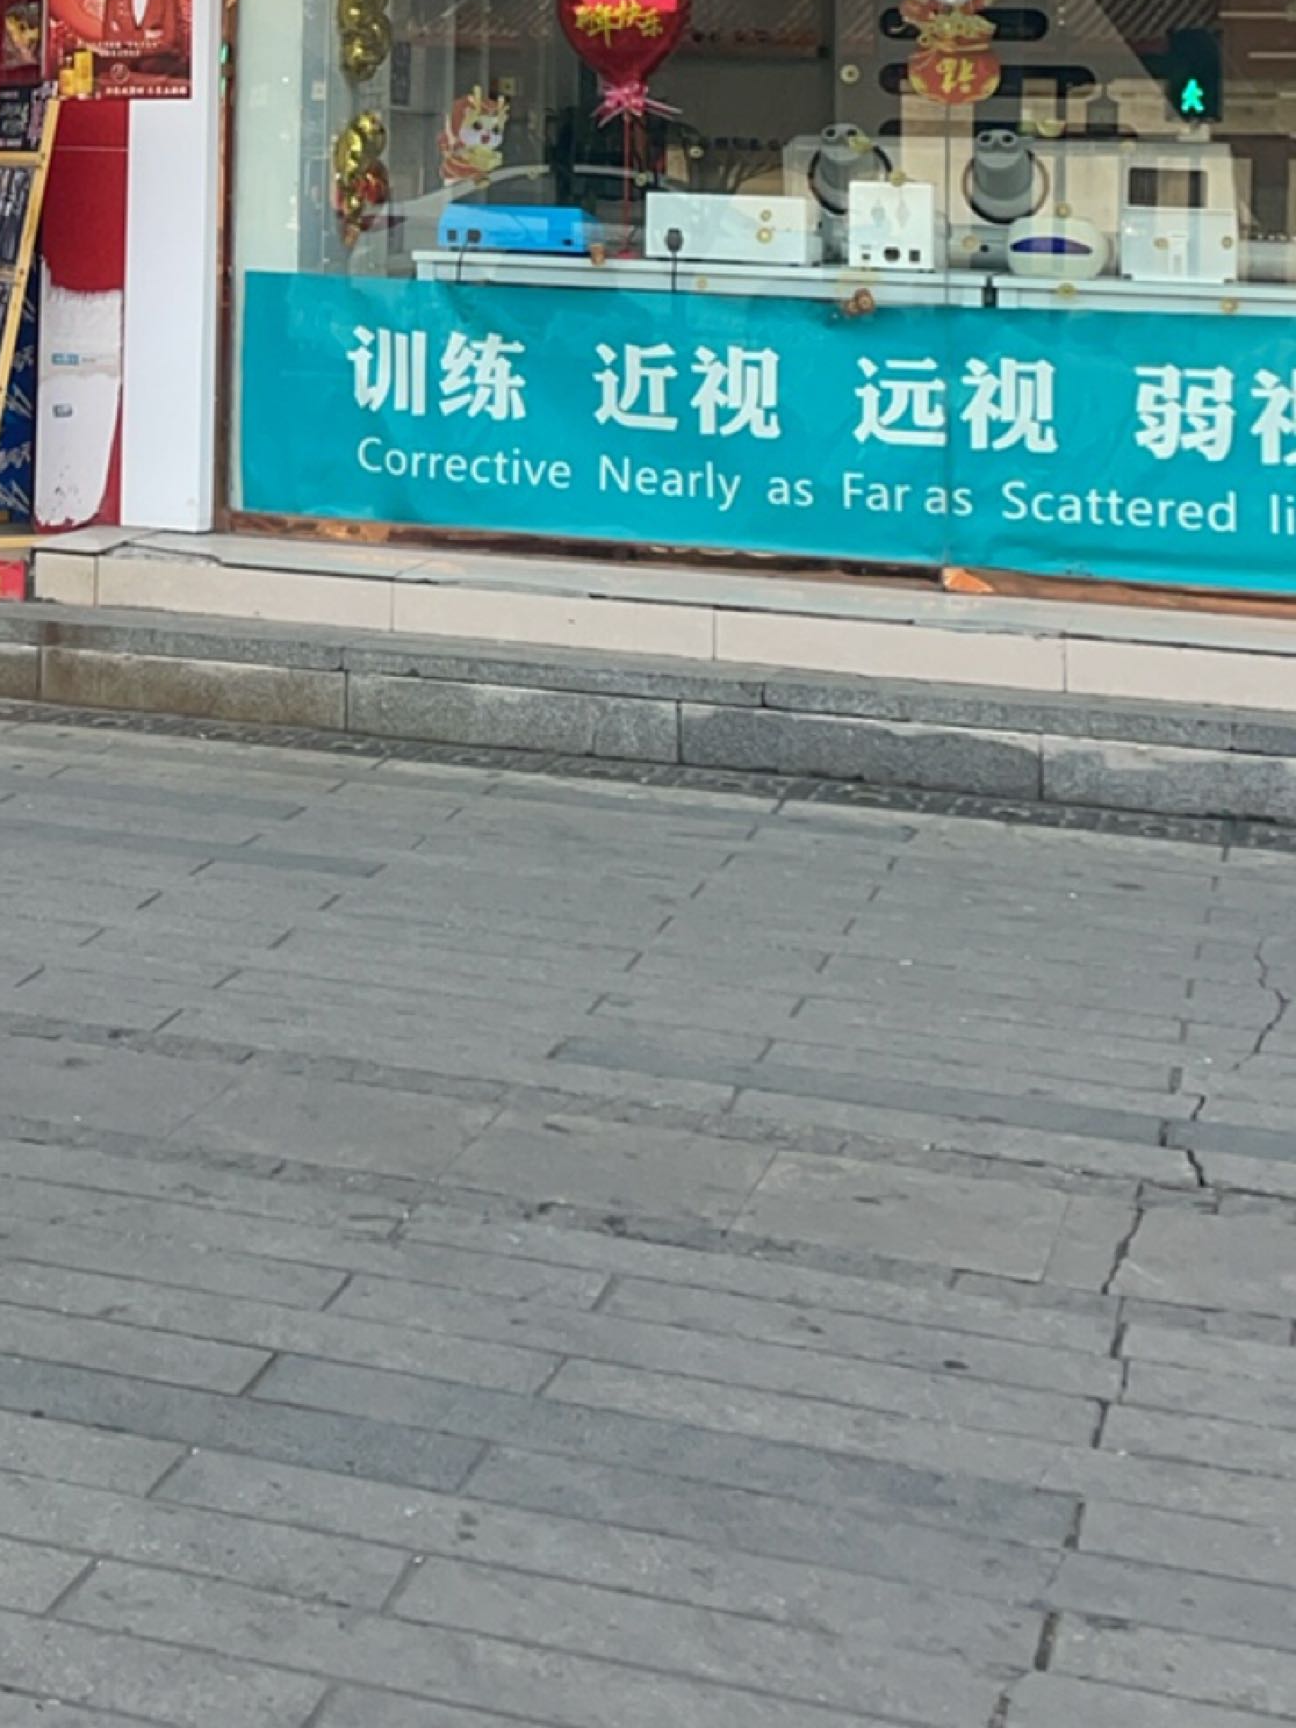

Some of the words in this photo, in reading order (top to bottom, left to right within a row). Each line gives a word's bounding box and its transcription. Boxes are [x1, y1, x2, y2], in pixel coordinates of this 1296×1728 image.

[345, 325, 527, 421] 训练
[592, 342, 782, 440] 近视
[853, 356, 1059, 455] 远视
[356, 436, 572, 490] Corrective
[598, 453, 742, 513] Nearly
[766, 475, 815, 508] as
[842, 472, 910, 513] Far
[923, 485, 974, 518] as
[1001, 480, 1238, 534] Scattered
